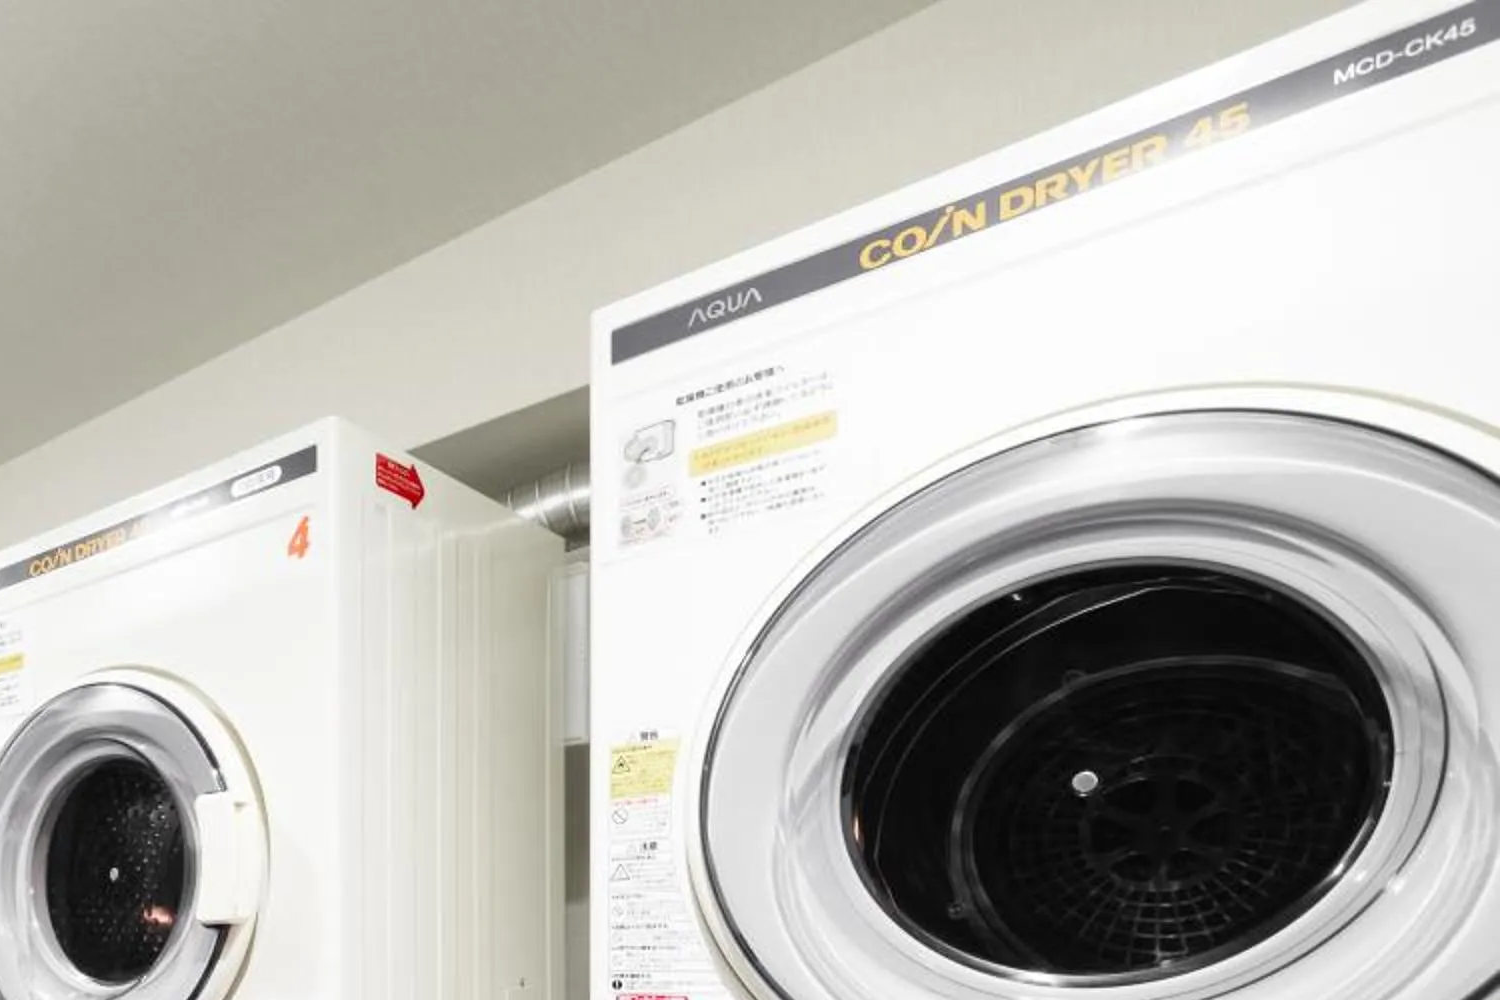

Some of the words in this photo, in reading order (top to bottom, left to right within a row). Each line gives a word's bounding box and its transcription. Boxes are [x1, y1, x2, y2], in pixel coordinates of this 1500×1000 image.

[688, 287, 762, 328] AQUA
[999, 134, 1168, 221] DRYER
[1184, 102, 1248, 148] 45
[1333, 17, 1477, 85] MCD-CK45
[288, 515, 309, 558] 4
